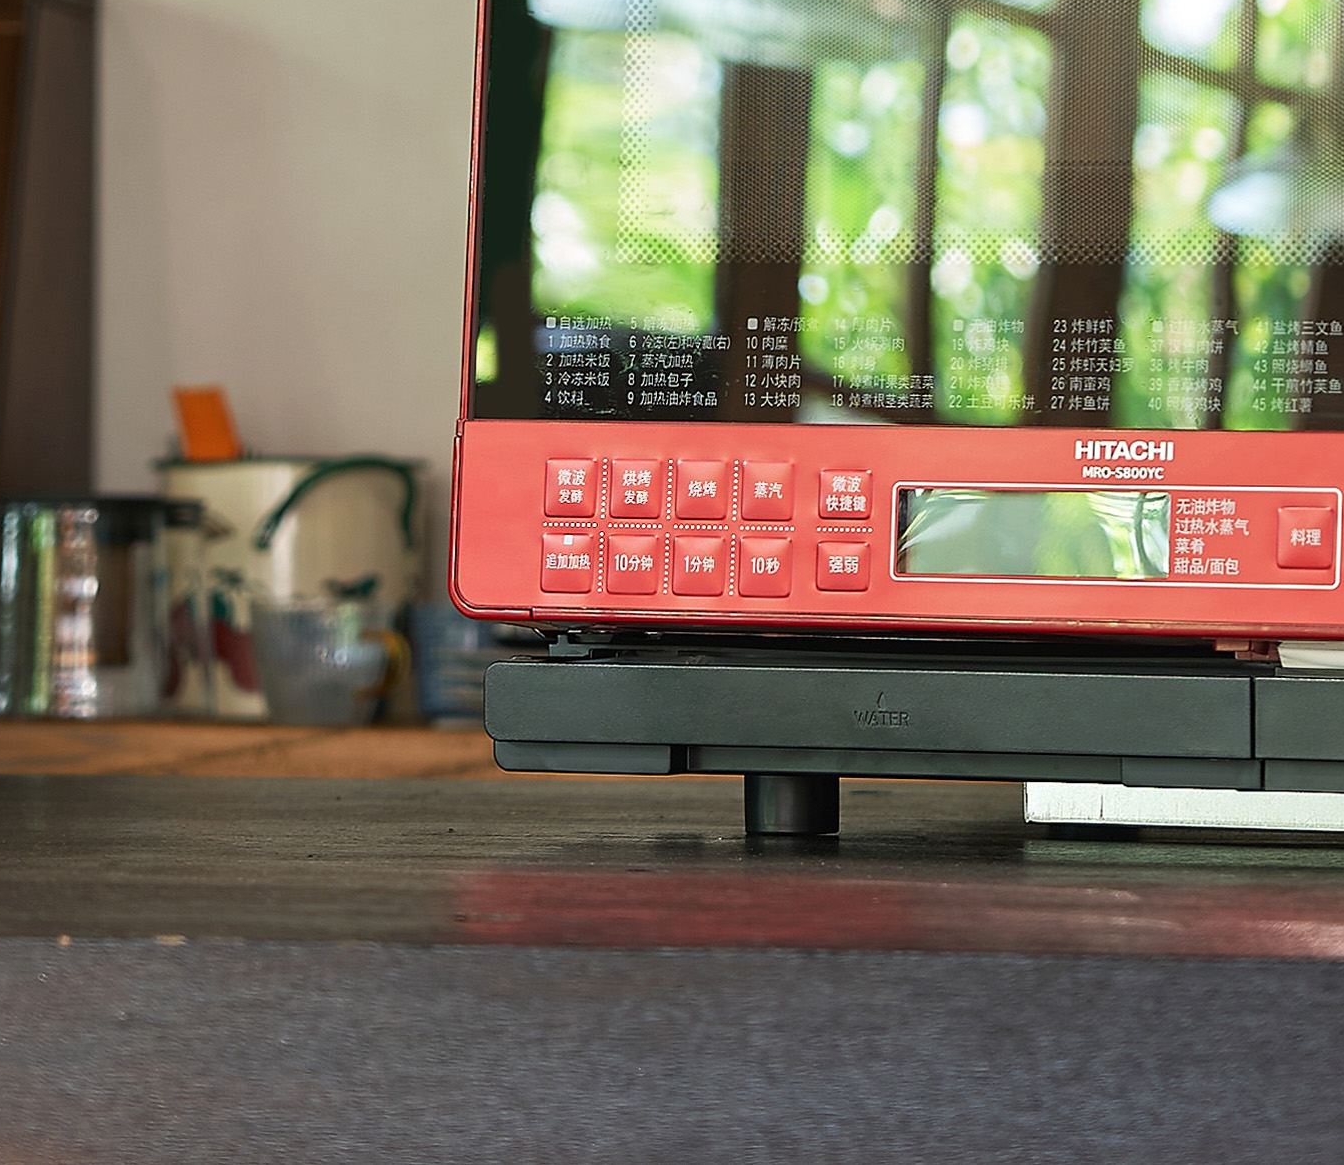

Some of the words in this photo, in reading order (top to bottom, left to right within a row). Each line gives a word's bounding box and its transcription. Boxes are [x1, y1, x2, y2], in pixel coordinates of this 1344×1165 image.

[560, 316, 612, 330] 自选加热
[836, 319, 846, 331] 14
[852, 318, 892, 333] 厚肉片
[1054, 320, 1067, 333] 23
[1072, 319, 1113, 334] 炸鲜虾
[1274, 321, 1343, 336] 盐烤三文鱼
[560, 335, 611, 349] 加热熟食
[747, 337, 758, 349] 10
[834, 337, 845, 349] 15
[953, 339, 963, 351] 19
[1053, 339, 1066, 352] 24
[1151, 340, 1163, 353] 37
[1255, 341, 1268, 353] 42
[559, 354, 611, 368] 加热米饭
[642, 354, 694, 369] 蒸汽加热
[746, 356, 757, 368] 11
[762, 355, 801, 370] 薄肉片
[833, 357, 845, 369] 16
[851, 356, 876, 370] 刺身
[951, 358, 963, 370] 20
[1053, 358, 1065, 371] 25
[1071, 358, 1134, 372] 炸虾天妇罗
[1150, 359, 1163, 372] 38
[1168, 359, 1208, 373] 烤牛肉
[1254, 360, 1267, 373] 43
[558, 373, 610, 386] 冷冻米饭
[641, 373, 693, 387] 加热包子
[745, 375, 756, 387] 12
[761, 374, 801, 388] 小块肉
[833, 376, 843, 387] 17
[950, 377, 963, 389] 21
[1052, 378, 1065, 390] 26
[1149, 379, 1162, 391] 39
[1253, 379, 1266, 392] 44
[640, 392, 718, 406] 加热油炸食品
[744, 393, 755, 406] 13
[761, 392, 800, 407] 大块肉
[831, 394, 843, 406] 18
[949, 396, 962, 408] 22
[1051, 397, 1064, 409] 27
[1069, 396, 1110, 411] 炸鱼饼
[1148, 398, 1161, 410] 40
[1253, 398, 1265, 411] 45
[1271, 398, 1313, 413] 烤红薯
[1075, 440, 1174, 461] HITACHI
[558, 469, 586, 486] 微波
[623, 470, 651, 486] 烘烤
[1083, 467, 1164, 479] MRO-S800YC
[688, 481, 716, 497] 烧烤
[754, 482, 783, 498] 蒸汽
[832, 476, 861, 492] 微波
[559, 490, 583, 503] 发酵
[624, 490, 648, 504] 发酵
[826, 496, 866, 511] 快捷键
[1176, 499, 1236, 515] 无油炸物
[1175, 519, 1250, 535] 过热水蒸气
[1291, 529, 1321, 546] 料理
[1175, 538, 1205, 554] 菜肴
[546, 554, 590, 569] 追加加热
[615, 554, 653, 571] 10分钟
[684, 556, 715, 572] 1分钟
[751, 557, 780, 574] 10秒
[829, 556, 859, 573] 强弱
[1174, 558, 1239, 575] 甜品/面包
[854, 711, 910, 727] WATER
